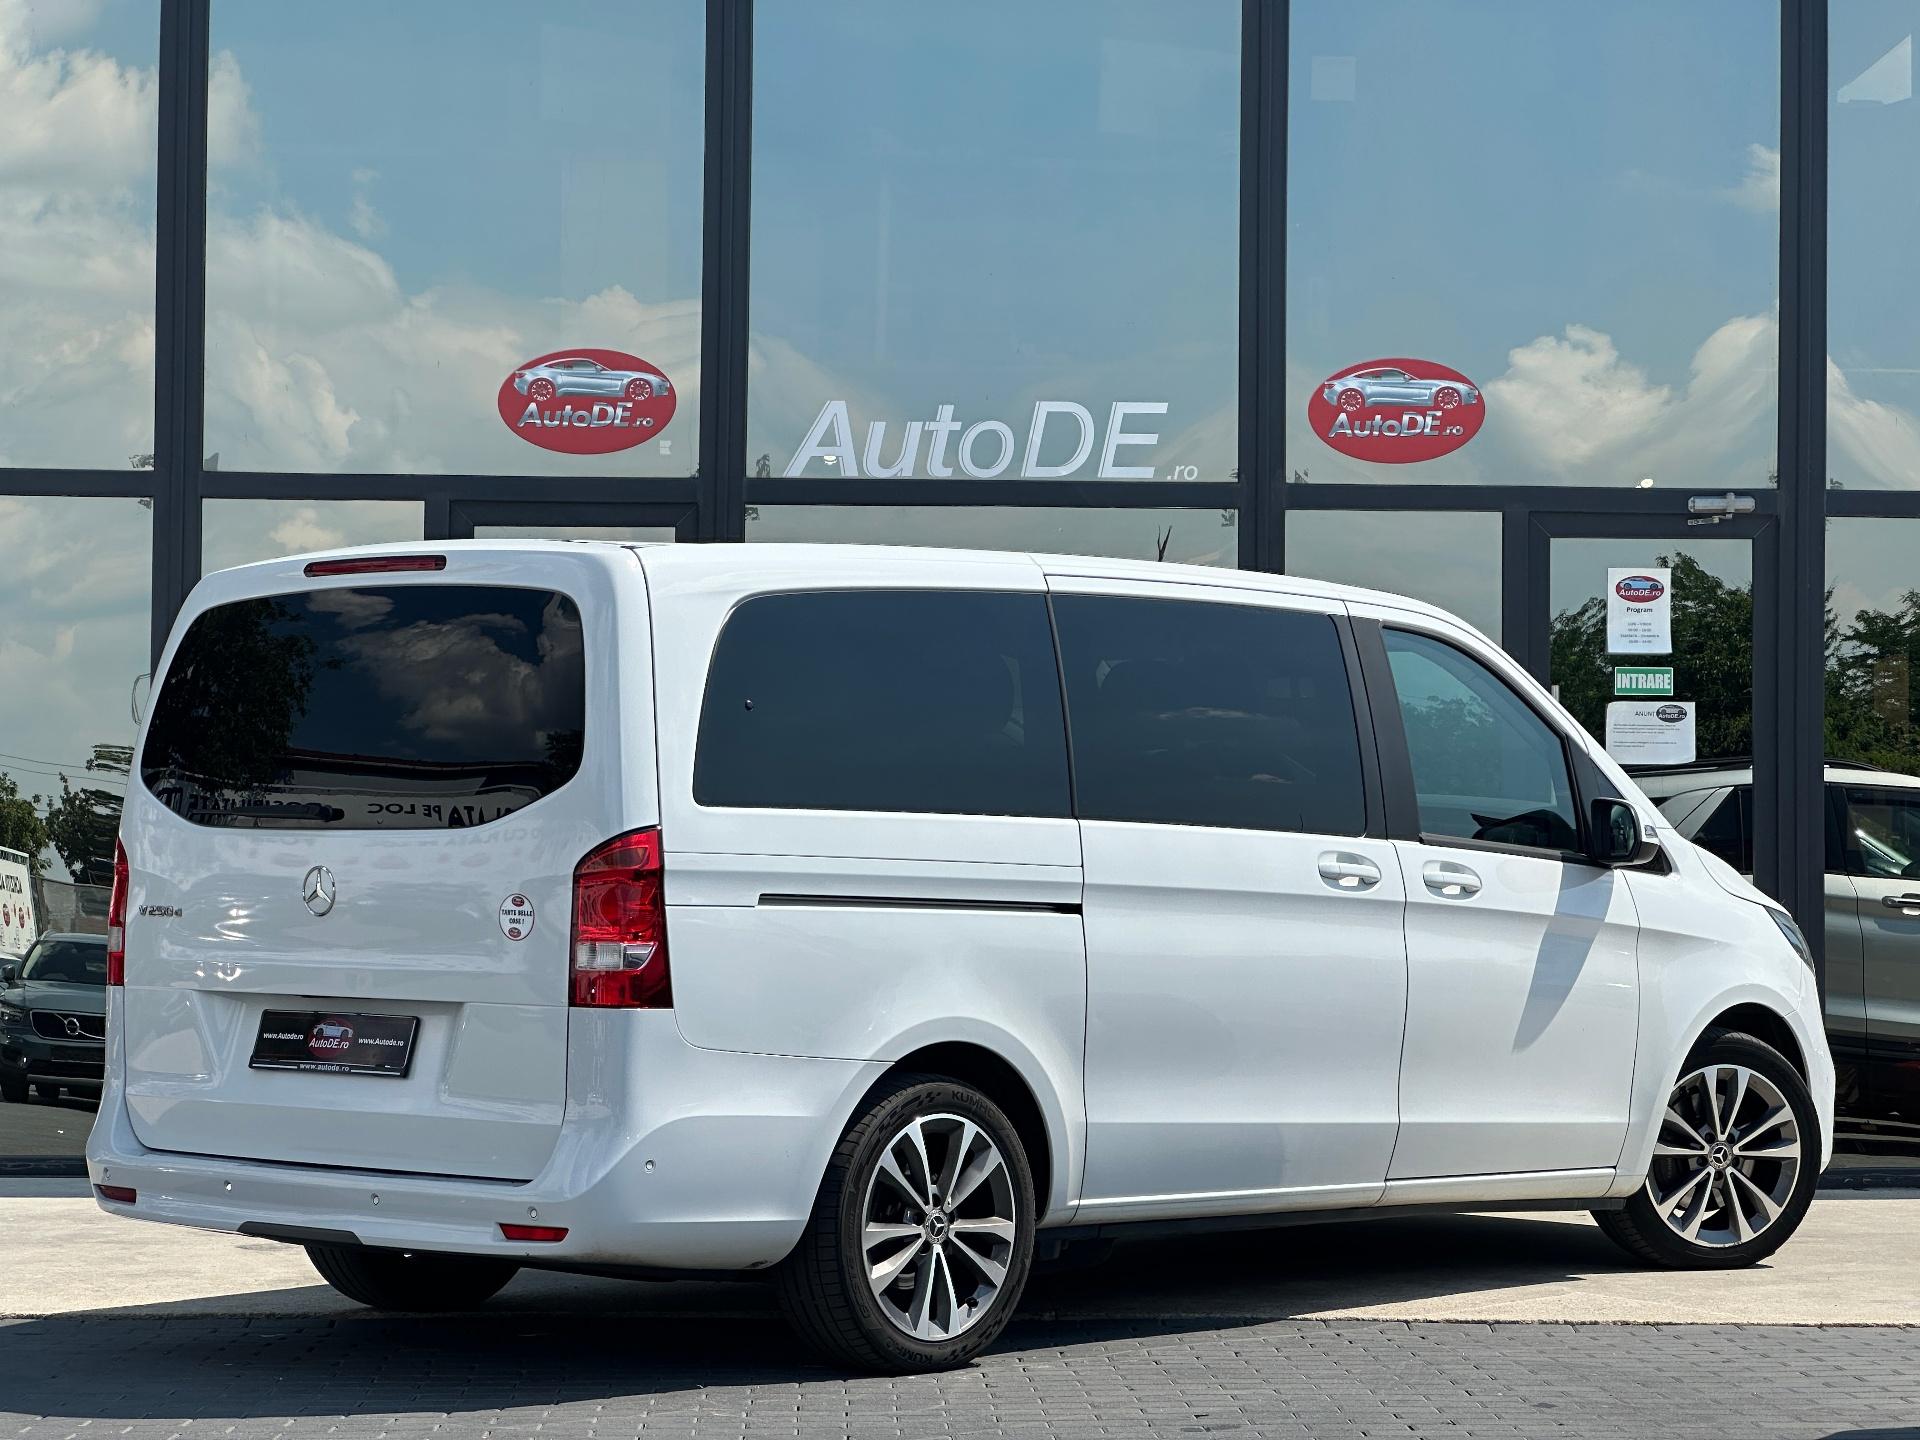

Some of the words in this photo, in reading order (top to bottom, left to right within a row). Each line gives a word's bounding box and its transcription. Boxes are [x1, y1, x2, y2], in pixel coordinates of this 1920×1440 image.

[1626, 606, 1653, 614] Program
[1616, 673, 1671, 689] INTRARE
[263, 1032, 304, 1041] www.Autode.ro
[308, 1037, 350, 1050] AutoDE.ro
[358, 1037, 404, 1047] www.Autode.ro
[299, 1063, 350, 1072] www.autode.ro
